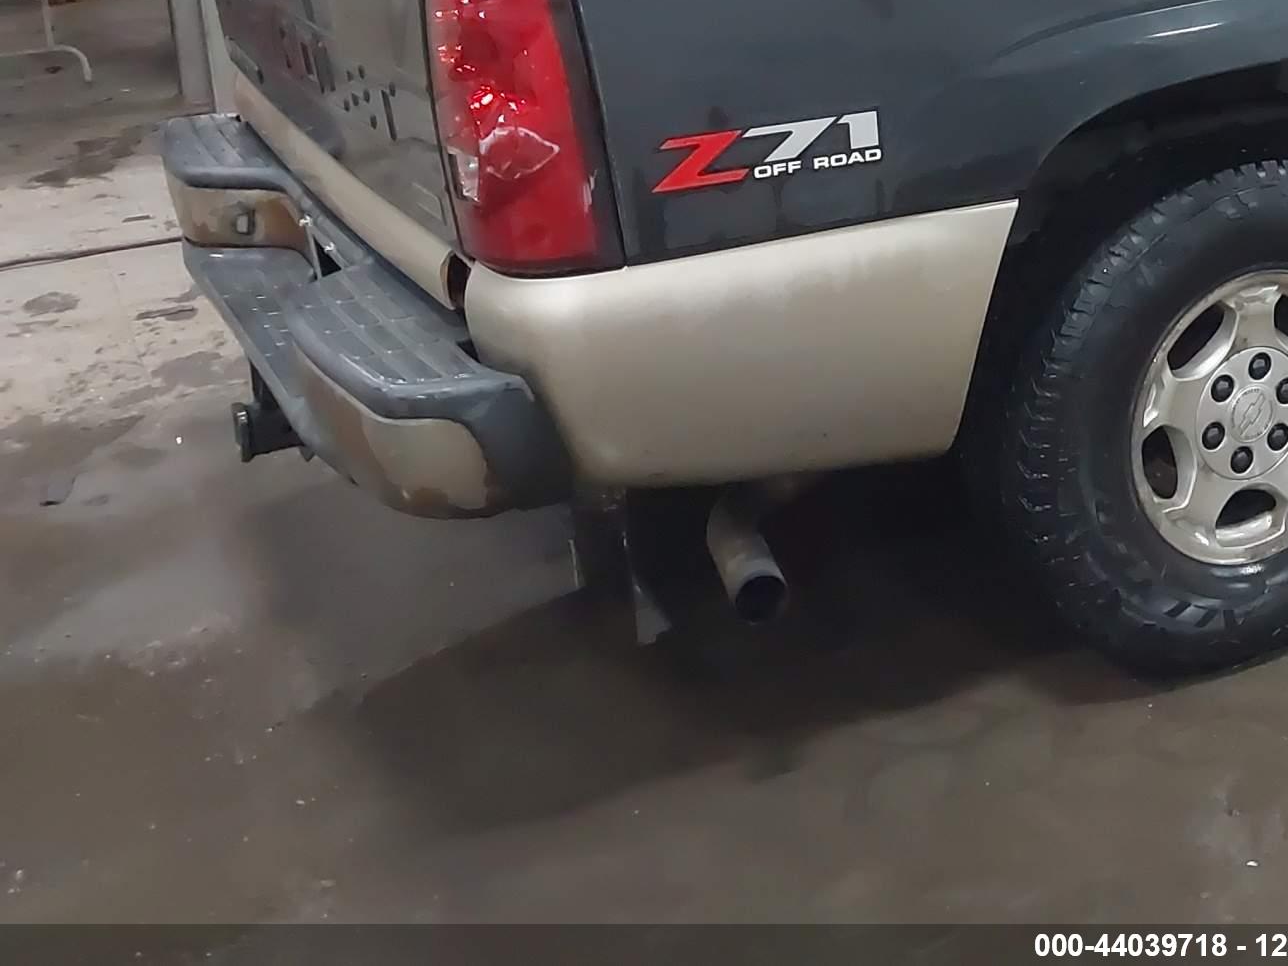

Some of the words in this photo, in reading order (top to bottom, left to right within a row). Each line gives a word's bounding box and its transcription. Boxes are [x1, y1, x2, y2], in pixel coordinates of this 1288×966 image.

[652, 111, 879, 193] Z71
[753, 161, 802, 179] OFF
[813, 148, 882, 169] ROAD
